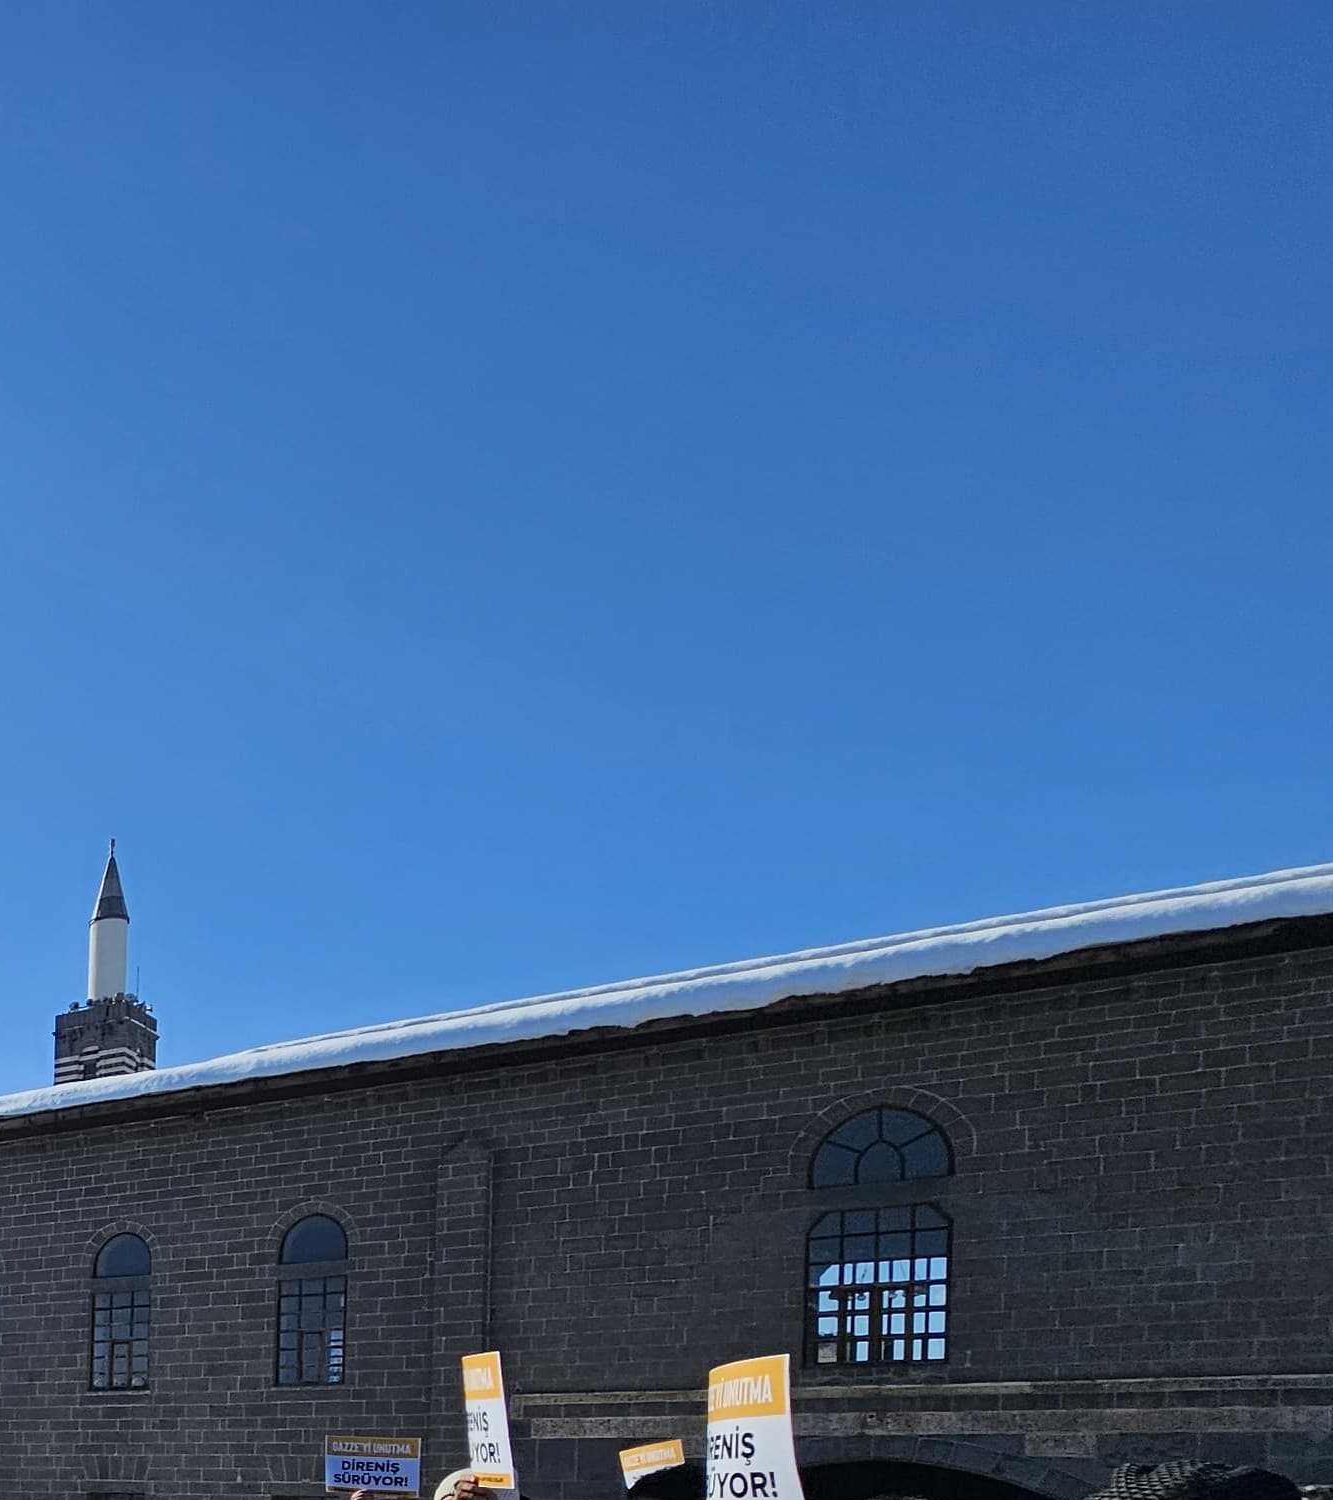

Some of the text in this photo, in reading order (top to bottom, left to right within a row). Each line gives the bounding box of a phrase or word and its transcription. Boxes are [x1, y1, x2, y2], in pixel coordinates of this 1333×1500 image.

[709, 1425, 755, 1467] RENİŞ
[341, 1458, 400, 1475] DİRENİŞ
[333, 1471, 409, 1487] SÜRÜYOR!
